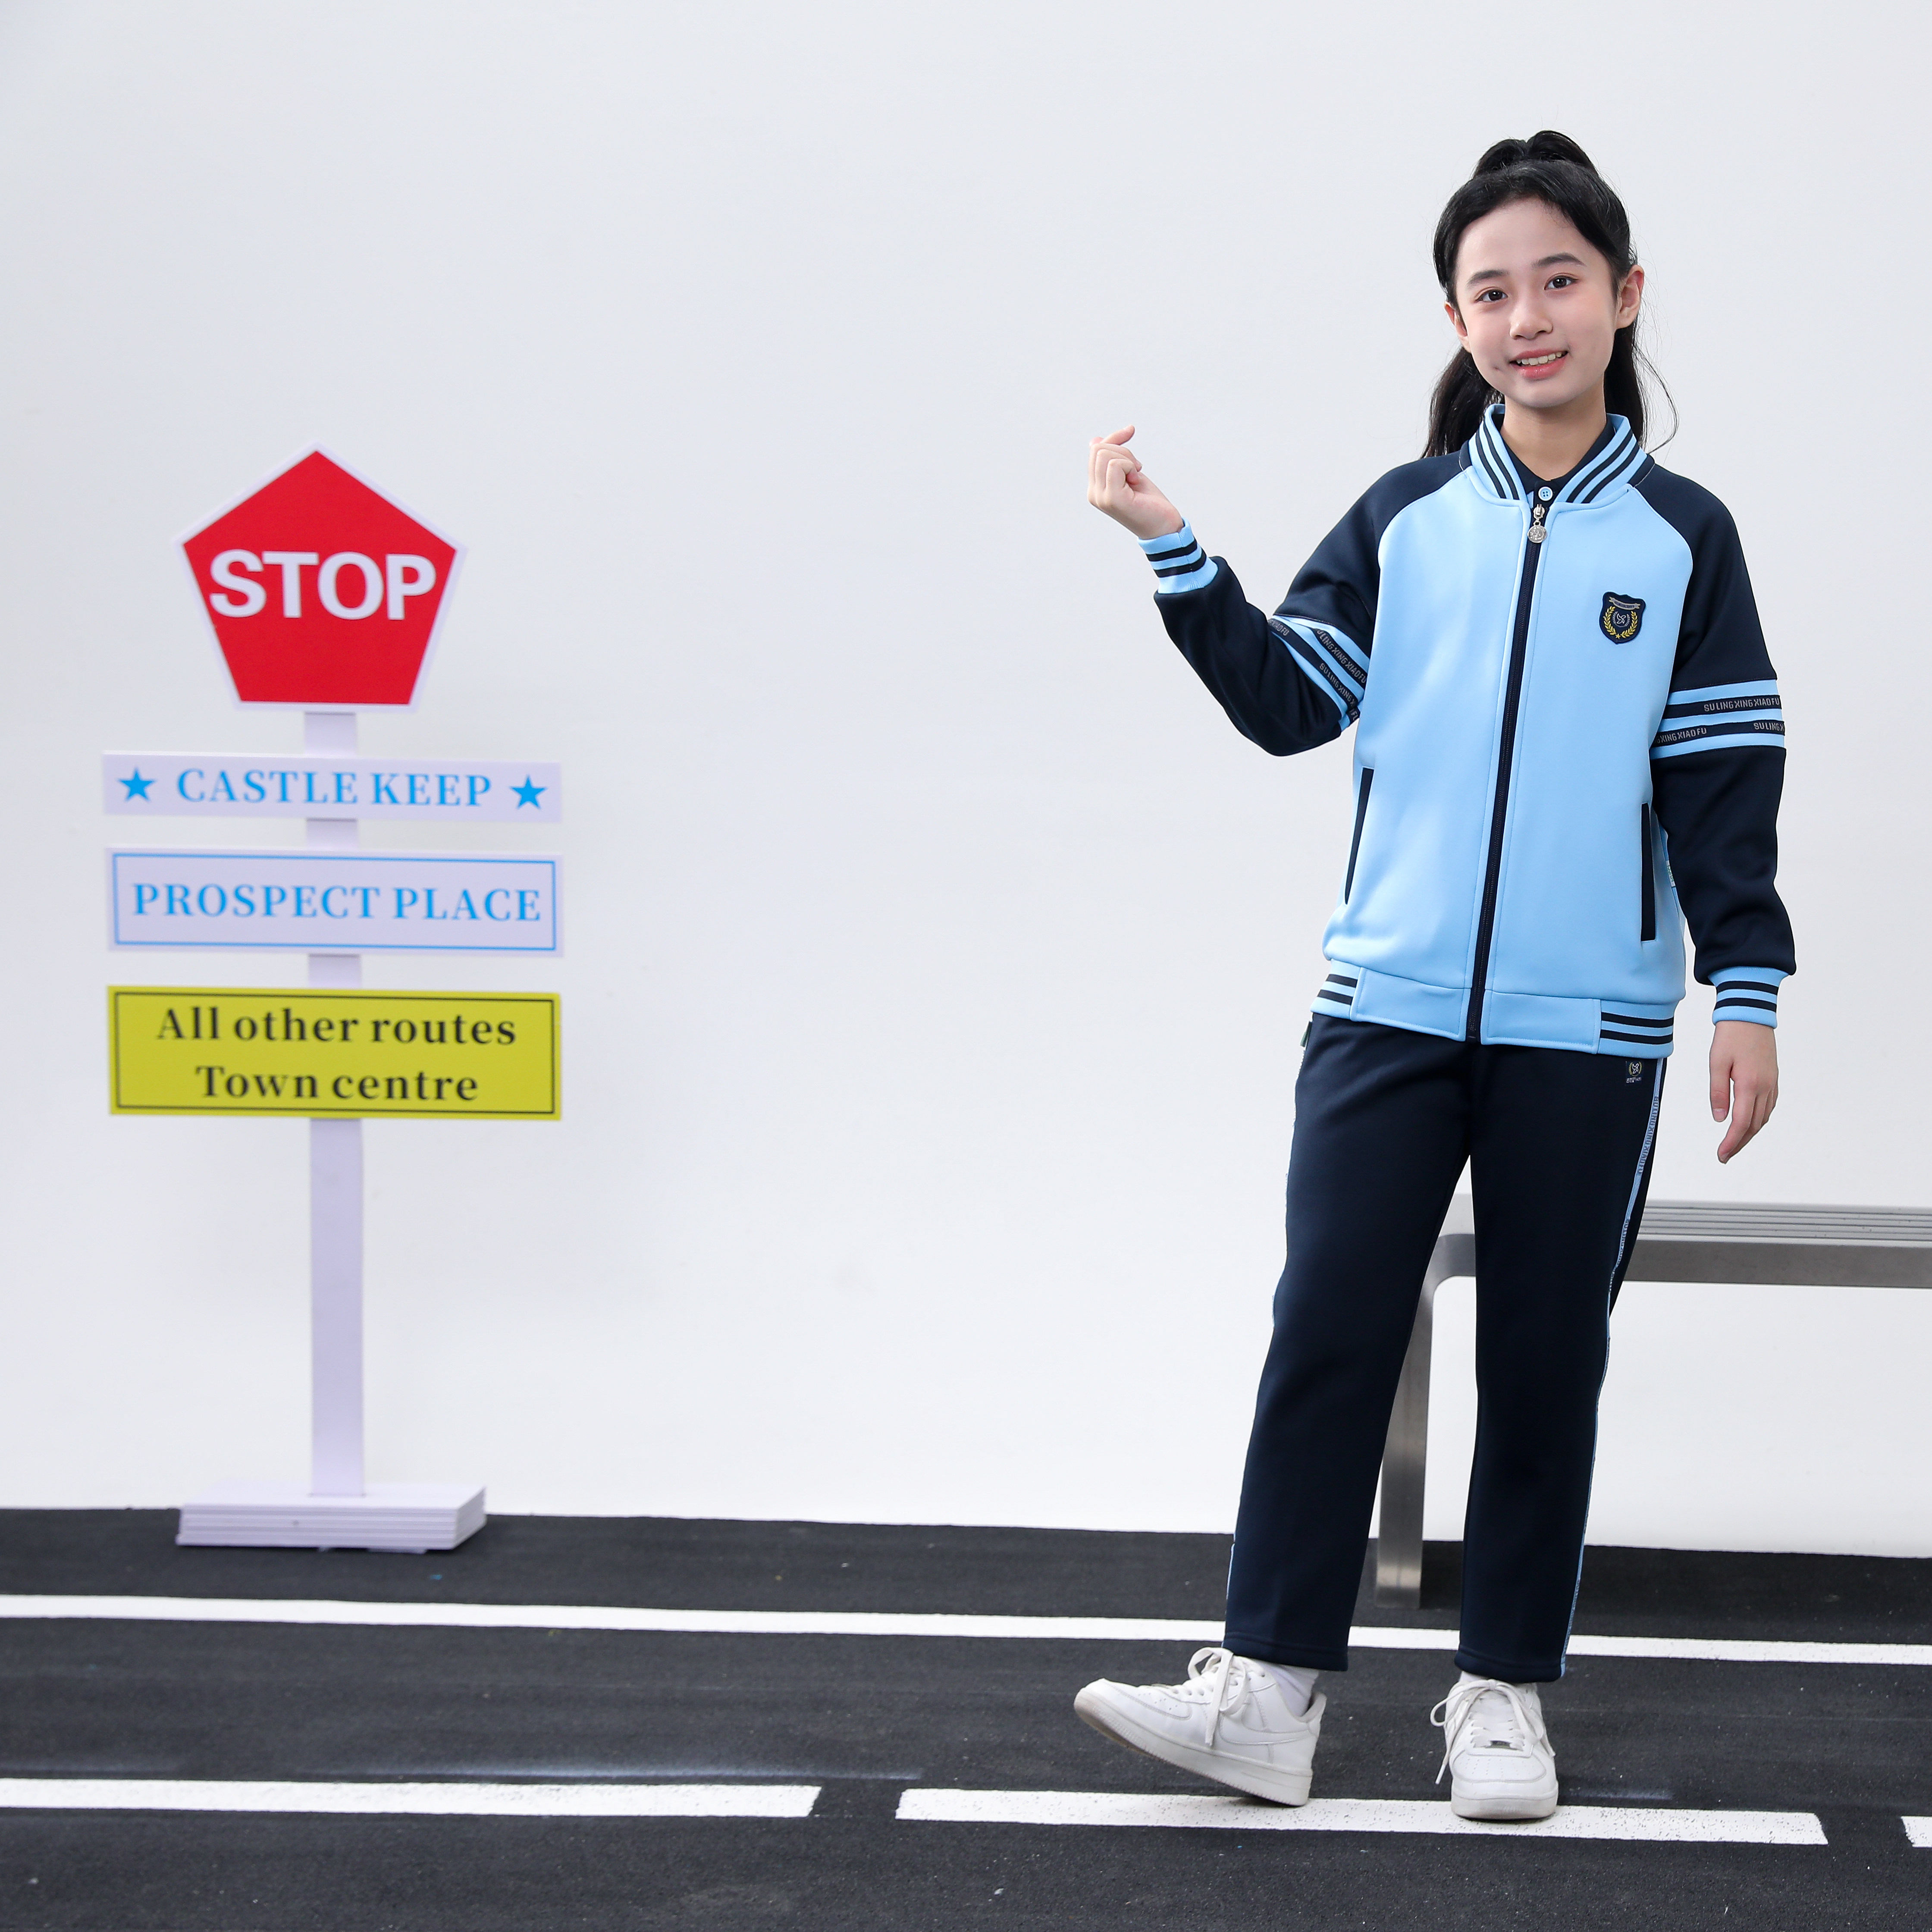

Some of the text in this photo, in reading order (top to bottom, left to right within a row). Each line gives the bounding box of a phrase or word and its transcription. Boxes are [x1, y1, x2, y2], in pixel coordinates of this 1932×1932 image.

[209, 549, 436, 621] STOP
[1734, 699, 1753, 708] XING
[177, 769, 492, 806] CASTLE KEEP
[133, 883, 541, 922] PROSPECT PLACE
[157, 1007, 516, 1045] All other routes
[195, 1066, 479, 1101] Town centre
